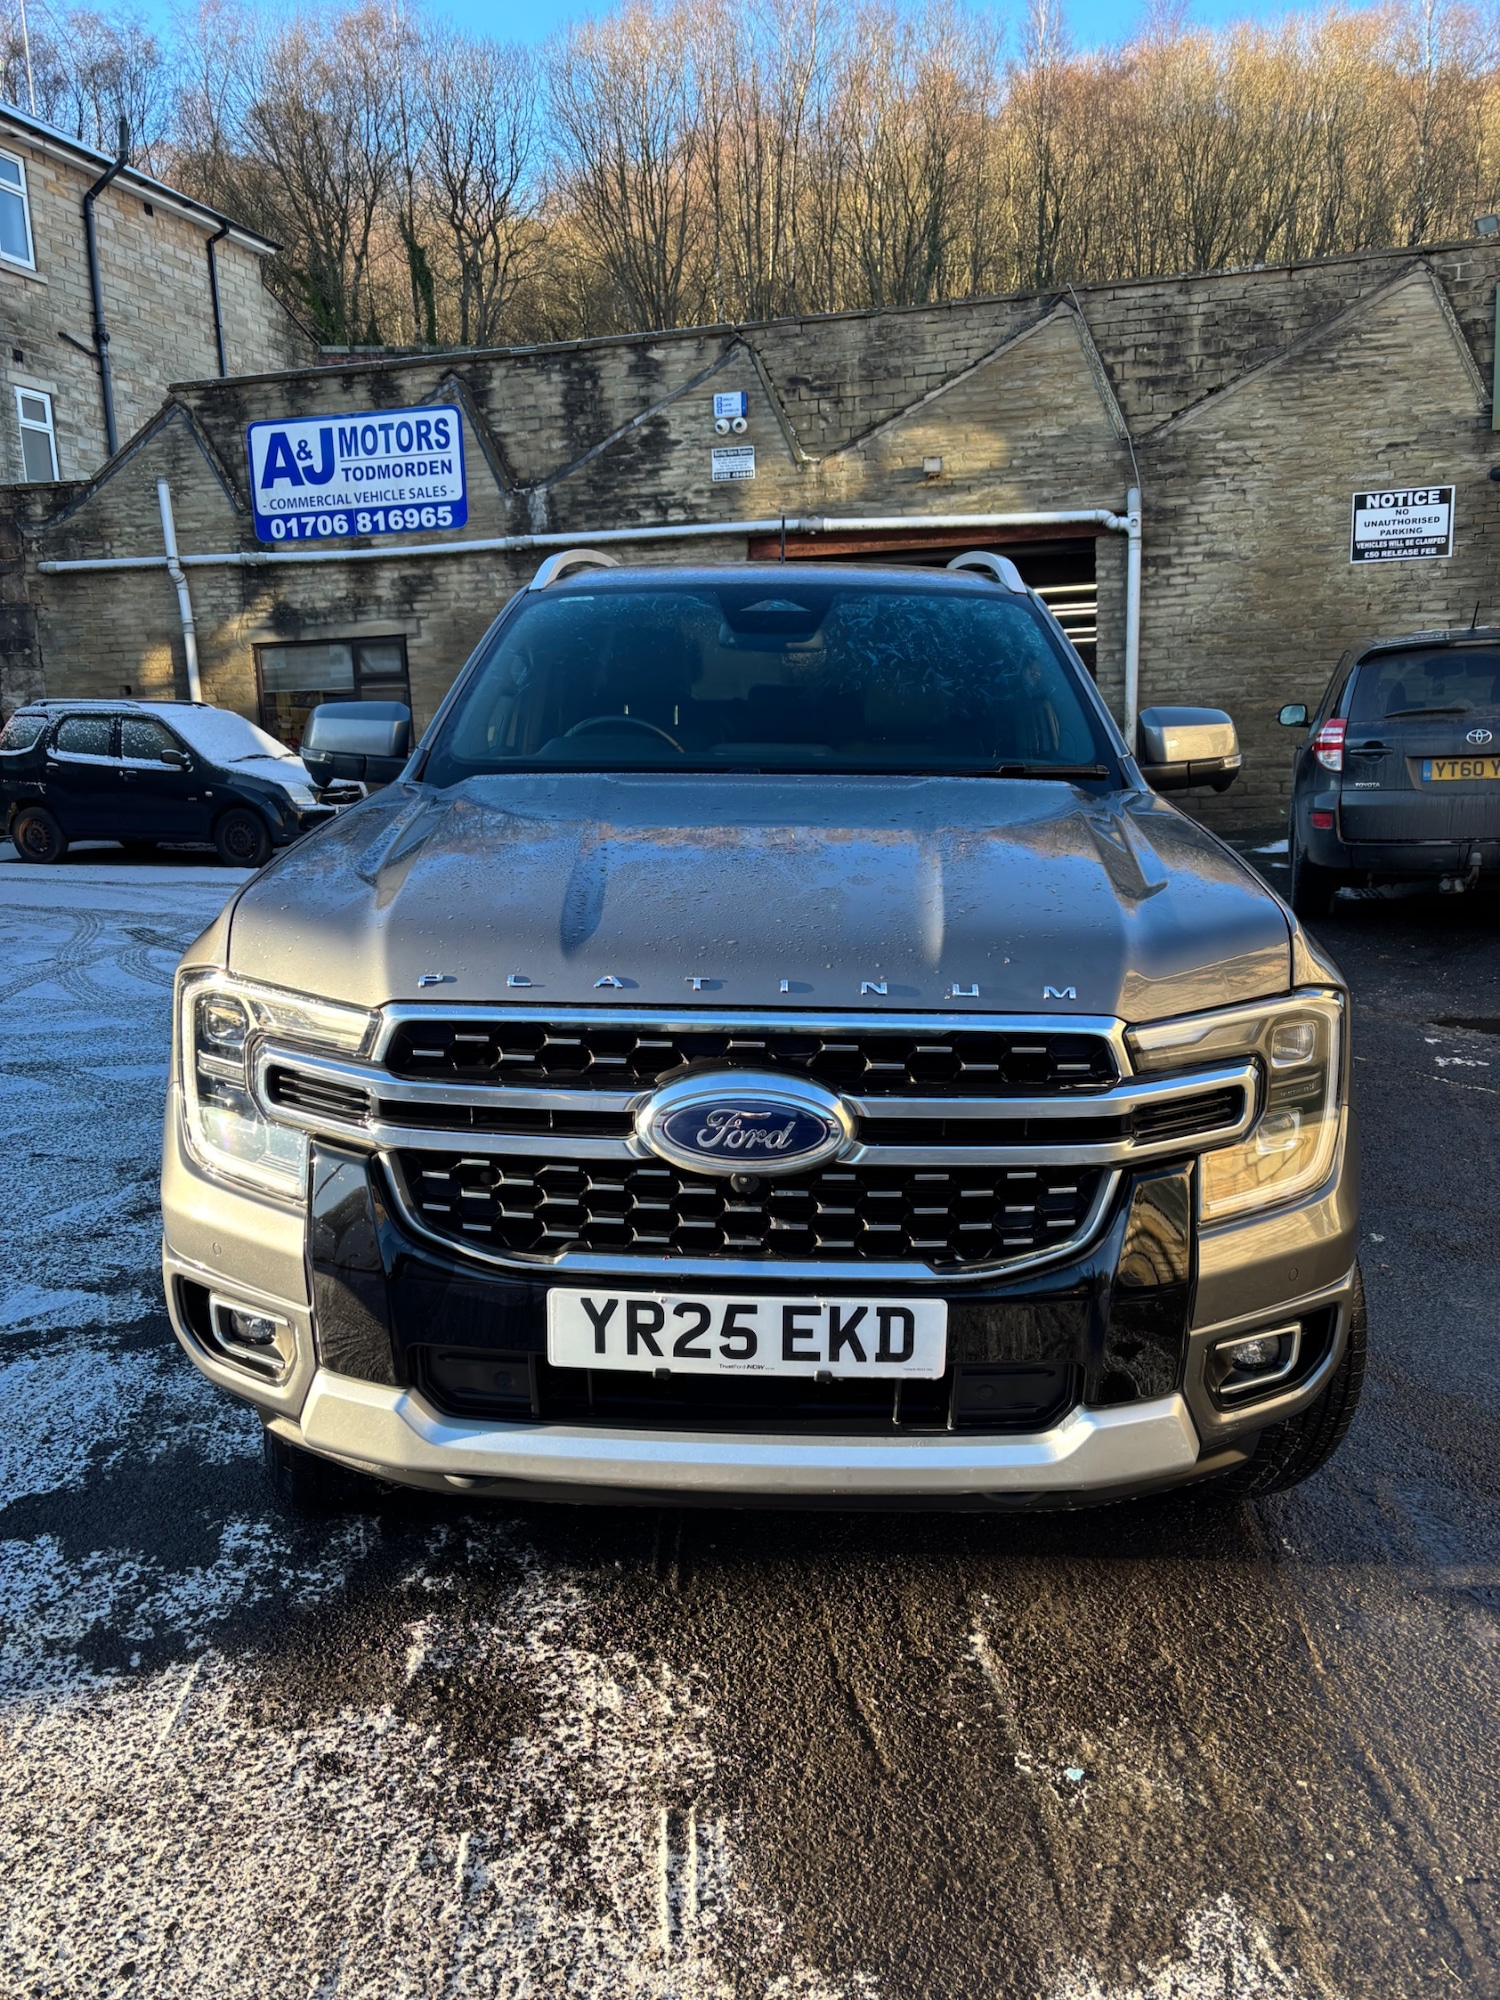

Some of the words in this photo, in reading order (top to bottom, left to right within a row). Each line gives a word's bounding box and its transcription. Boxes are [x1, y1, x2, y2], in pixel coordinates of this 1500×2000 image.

[261, 427, 335, 489] A&J
[339, 418, 450, 458] MOTORS
[341, 459, 453, 482] TODMORDEN
[269, 493, 352, 510] COMMERCIAL
[353, 488, 405, 504] VEHICLE
[409, 485, 447, 499] SALES
[1366, 490, 1440, 509] NOTICE
[270, 514, 349, 539] 01706
[356, 506, 453, 533] 816965
[1364, 516, 1440, 528] UNAUTHORISED
[1395, 508, 1409, 516] NO
[1380, 527, 1423, 537] PARKING
[1356, 541, 1388, 550] VEHICLES
[1388, 540, 1404, 548] WILL
[1416, 537, 1447, 546] CLAMPED
[1364, 551, 1379, 559] £50
[1381, 548, 1418, 558] RELEASE
[1421, 547, 1437, 555] FEE
[1435, 760, 1485, 777] YT60
[417, 973, 1078, 1000] PLATINUM
[696, 1108, 797, 1150] Ford
[580, 1297, 758, 1360] YR25
[782, 1305, 915, 1363] EKD
